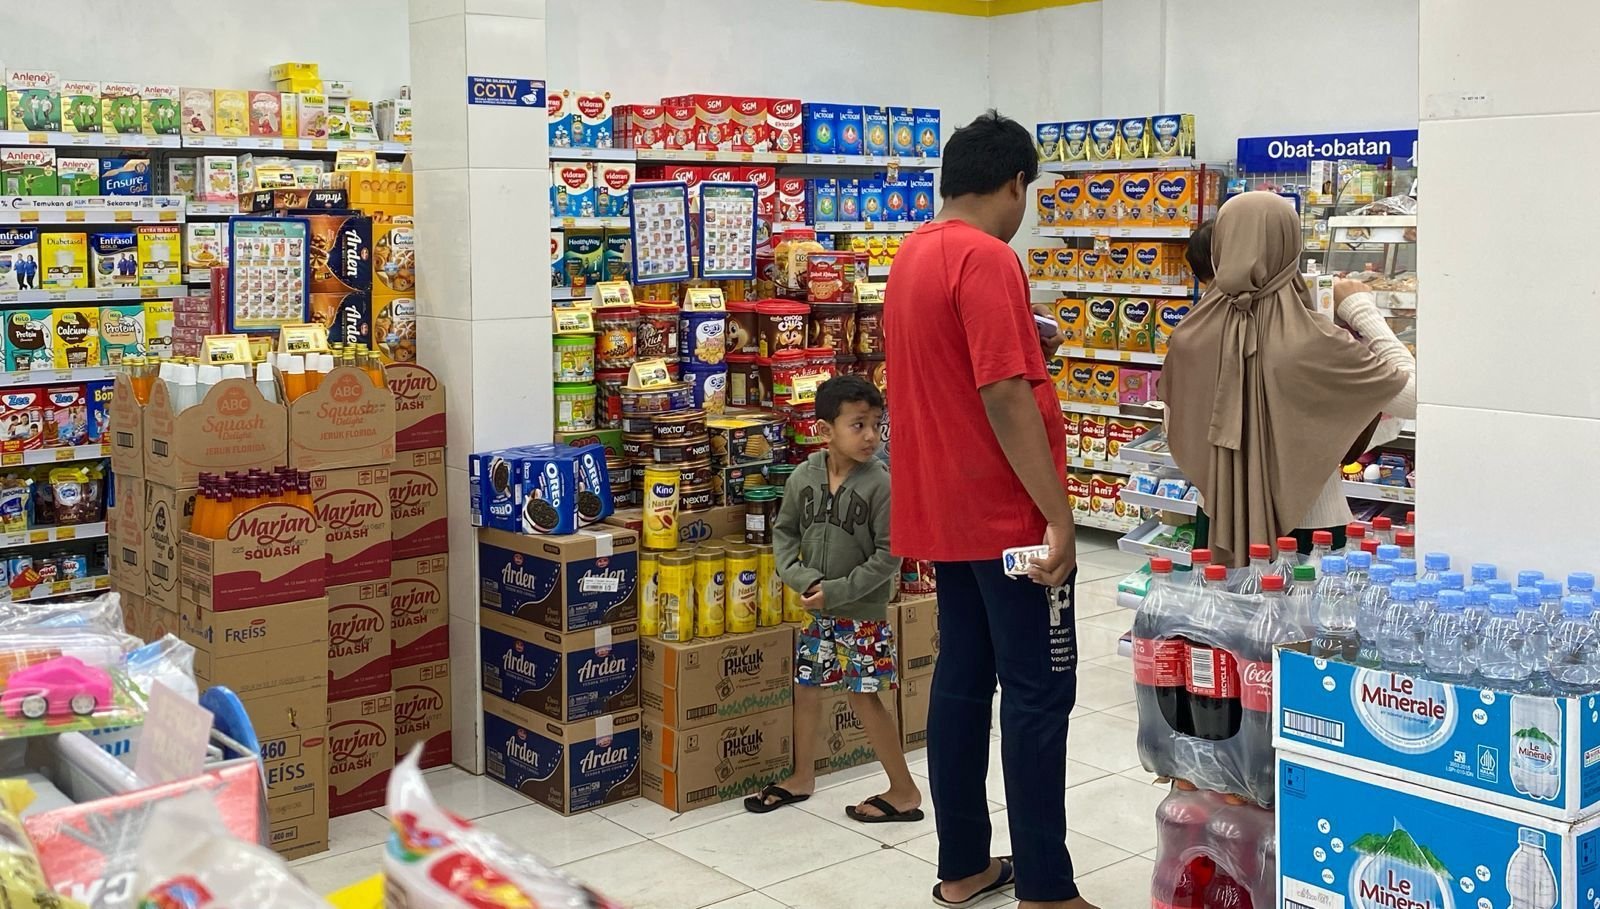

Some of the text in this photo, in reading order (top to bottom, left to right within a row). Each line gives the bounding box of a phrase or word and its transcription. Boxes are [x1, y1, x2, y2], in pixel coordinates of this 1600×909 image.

[12, 72, 46, 82] Anlene
[64, 83, 90, 91] Anlene
[144, 86, 171, 94] Anlene
[473, 83, 517, 98] CCTV
[579, 100, 602, 108] vidoran
[706, 99, 723, 109] SGM
[740, 101, 757, 111] SGM
[775, 103, 794, 115] SGM
[1267, 137, 1391, 159] Obat-obatan
[7, 151, 41, 161] Anlene
[62, 160, 90, 168] Anlene
[562, 171, 586, 179] vidoran
[675, 170, 693, 180] SGM
[711, 171, 730, 182] SGM
[749, 172, 767, 182] SGM
[106, 176, 144, 190] Ensure
[129, 184, 148, 194] Gold
[784, 181, 799, 191] SGM
[1090, 185, 1111, 194] Bebelac
[1125, 185, 1146, 193] Bebelac
[1160, 184, 1182, 193] Bebelac
[106, 200, 142, 208] Sekarang!
[0, 231, 33, 240] ntrasol
[46, 238, 83, 246] Diabetasol
[100, 237, 133, 245] Entrasol
[143, 234, 177, 242] Diabetasol
[345, 229, 362, 276] Arden
[1163, 311, 1184, 320] Bebela
[57, 326, 87, 335] Calcium
[105, 323, 135, 333] Protein
[345, 304, 361, 345] Arde
[15, 330, 37, 339] Protein
[334, 386, 360, 398] ABC
[388, 373, 438, 400] arjan
[8, 395, 30, 405] Zee
[55, 393, 74, 404] Zee
[219, 400, 249, 411] ABC
[316, 400, 376, 425] Squash
[202, 414, 265, 441] Squash
[319, 428, 377, 441] JERUK FLORIDA
[205, 443, 266, 456] JERUK FLORIDA
[584, 454, 600, 495] OREO
[546, 463, 560, 508] OREO
[389, 480, 439, 509] arjan
[314, 499, 384, 529] Marjan
[490, 503, 512, 515] OREO
[799, 483, 868, 536] GAP
[228, 512, 318, 545] Marjan
[679, 519, 708, 542] ery
[326, 529, 368, 543] QUASH
[231, 546, 244, 554] 225
[244, 545, 300, 560] SQUASH
[501, 562, 536, 590] Arden
[391, 587, 442, 617] arjan
[391, 615, 428, 629] QUASH
[328, 614, 385, 647] arjan
[328, 643, 369, 659] QUASH
[502, 649, 536, 678] Arden
[1221, 653, 1227, 663] ME
[577, 657, 627, 683] Arden
[731, 663, 761, 676] HARUM
[1390, 672, 1413, 695] Le
[1361, 683, 1445, 720] Minerale
[394, 694, 444, 724] arjan
[835, 708, 857, 731] puc
[260, 740, 286, 760] 460
[328, 729, 387, 762] arjan
[505, 735, 539, 767] Arden
[730, 743, 760, 757] HARUM
[1530, 742, 1540, 752] Le
[580, 747, 628, 774] Arden
[1518, 746, 1552, 762] Minerale
[329, 758, 372, 775] QUASH
[1388, 870, 1411, 895] Le
[1360, 880, 1430, 909] Mineral
